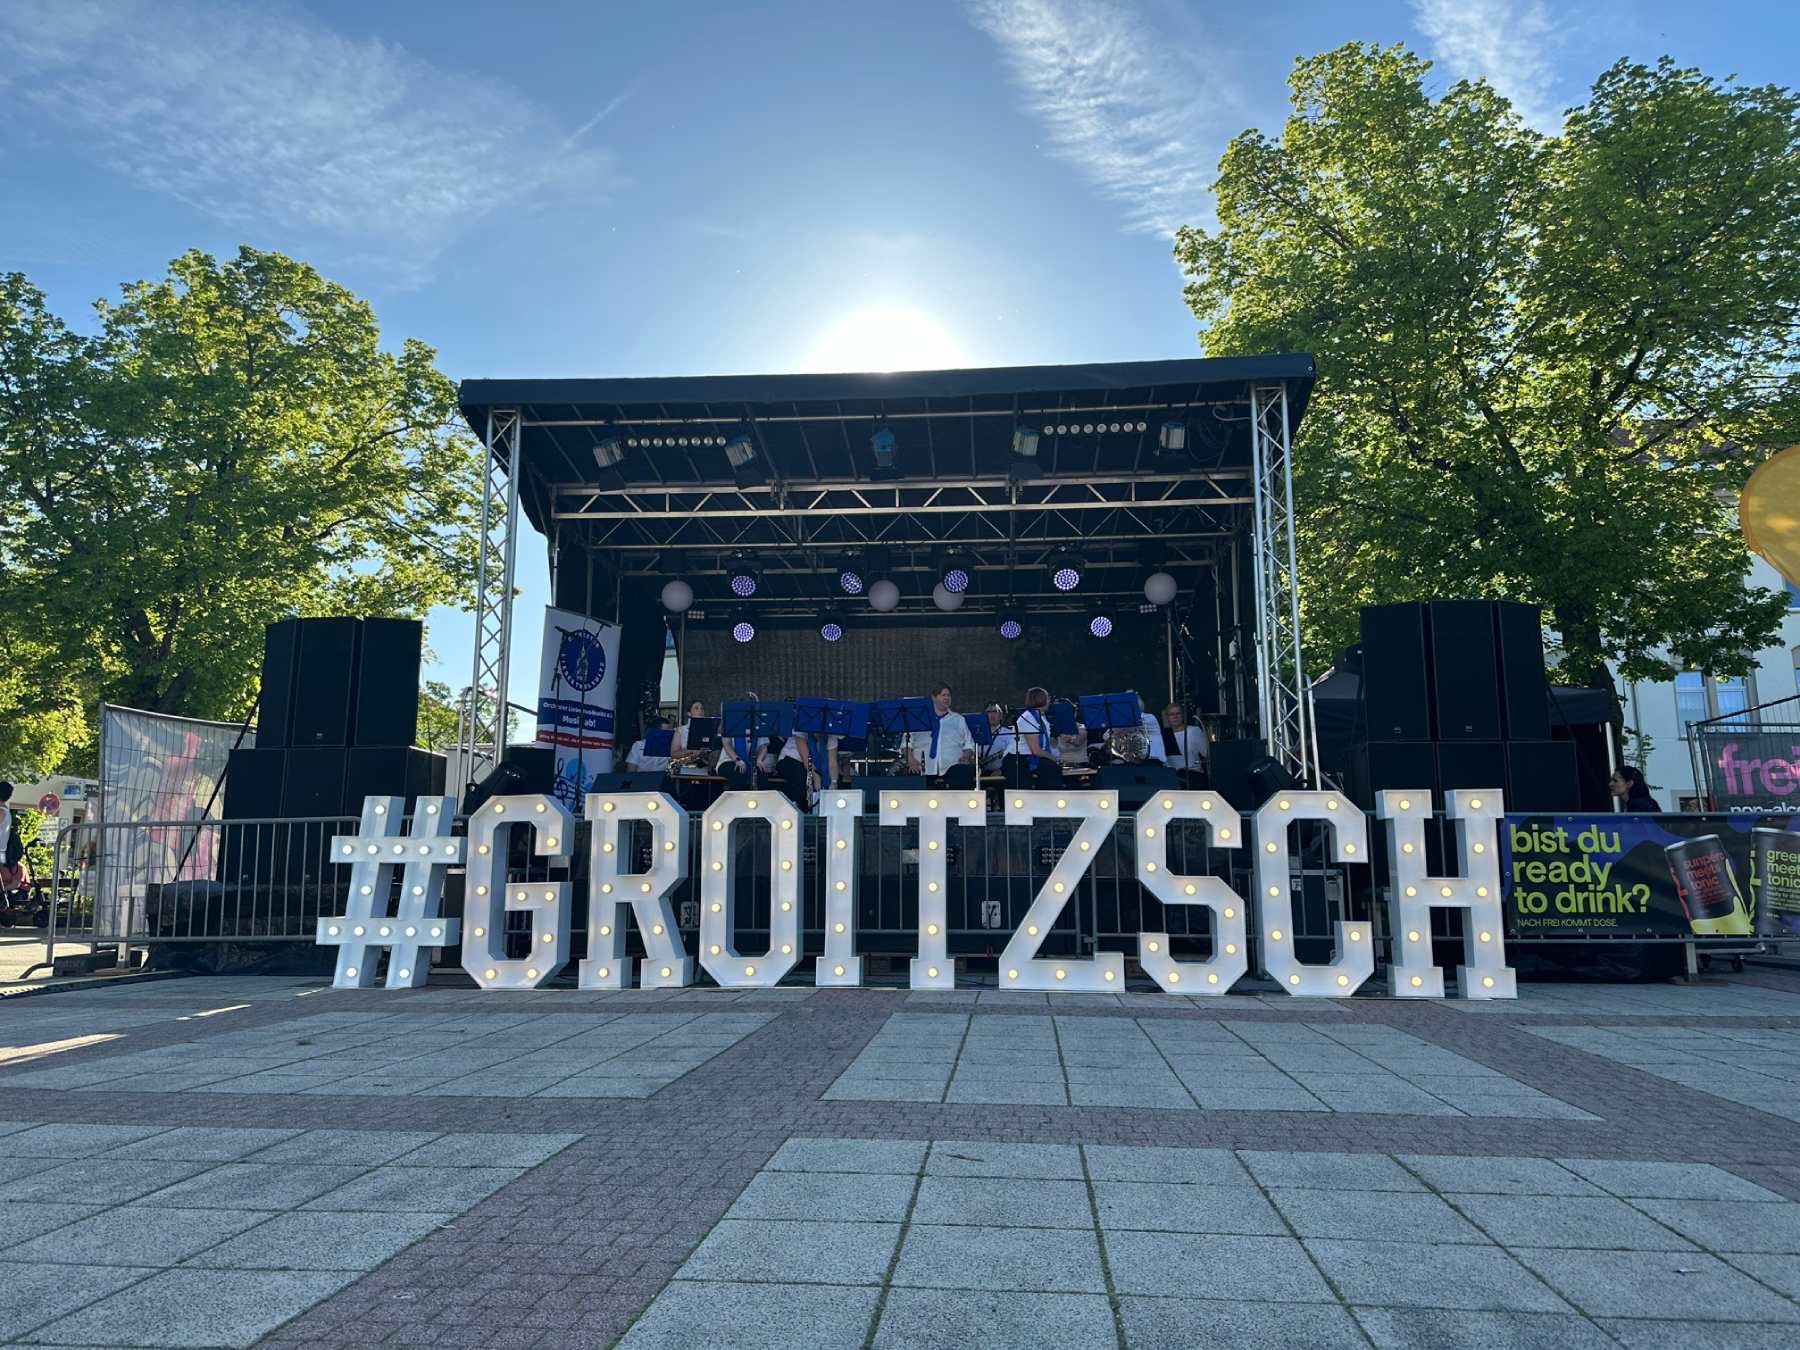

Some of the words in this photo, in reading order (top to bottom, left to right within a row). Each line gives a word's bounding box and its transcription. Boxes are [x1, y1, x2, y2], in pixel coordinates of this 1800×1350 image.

[562, 715, 580, 725] Musi
[1510, 823, 1570, 853] bist
[1577, 824, 1622, 853] du
[1767, 850, 1800, 863] gree
[1512, 854, 1612, 890] ready
[316, 788, 1518, 1000] #GROITZSCH
[1514, 886, 1548, 913] to
[1555, 884, 1650, 913] drink?
[1517, 919, 1541, 927] NACH
[1542, 919, 1560, 927] FREI
[1562, 919, 1592, 927] KOMMT
